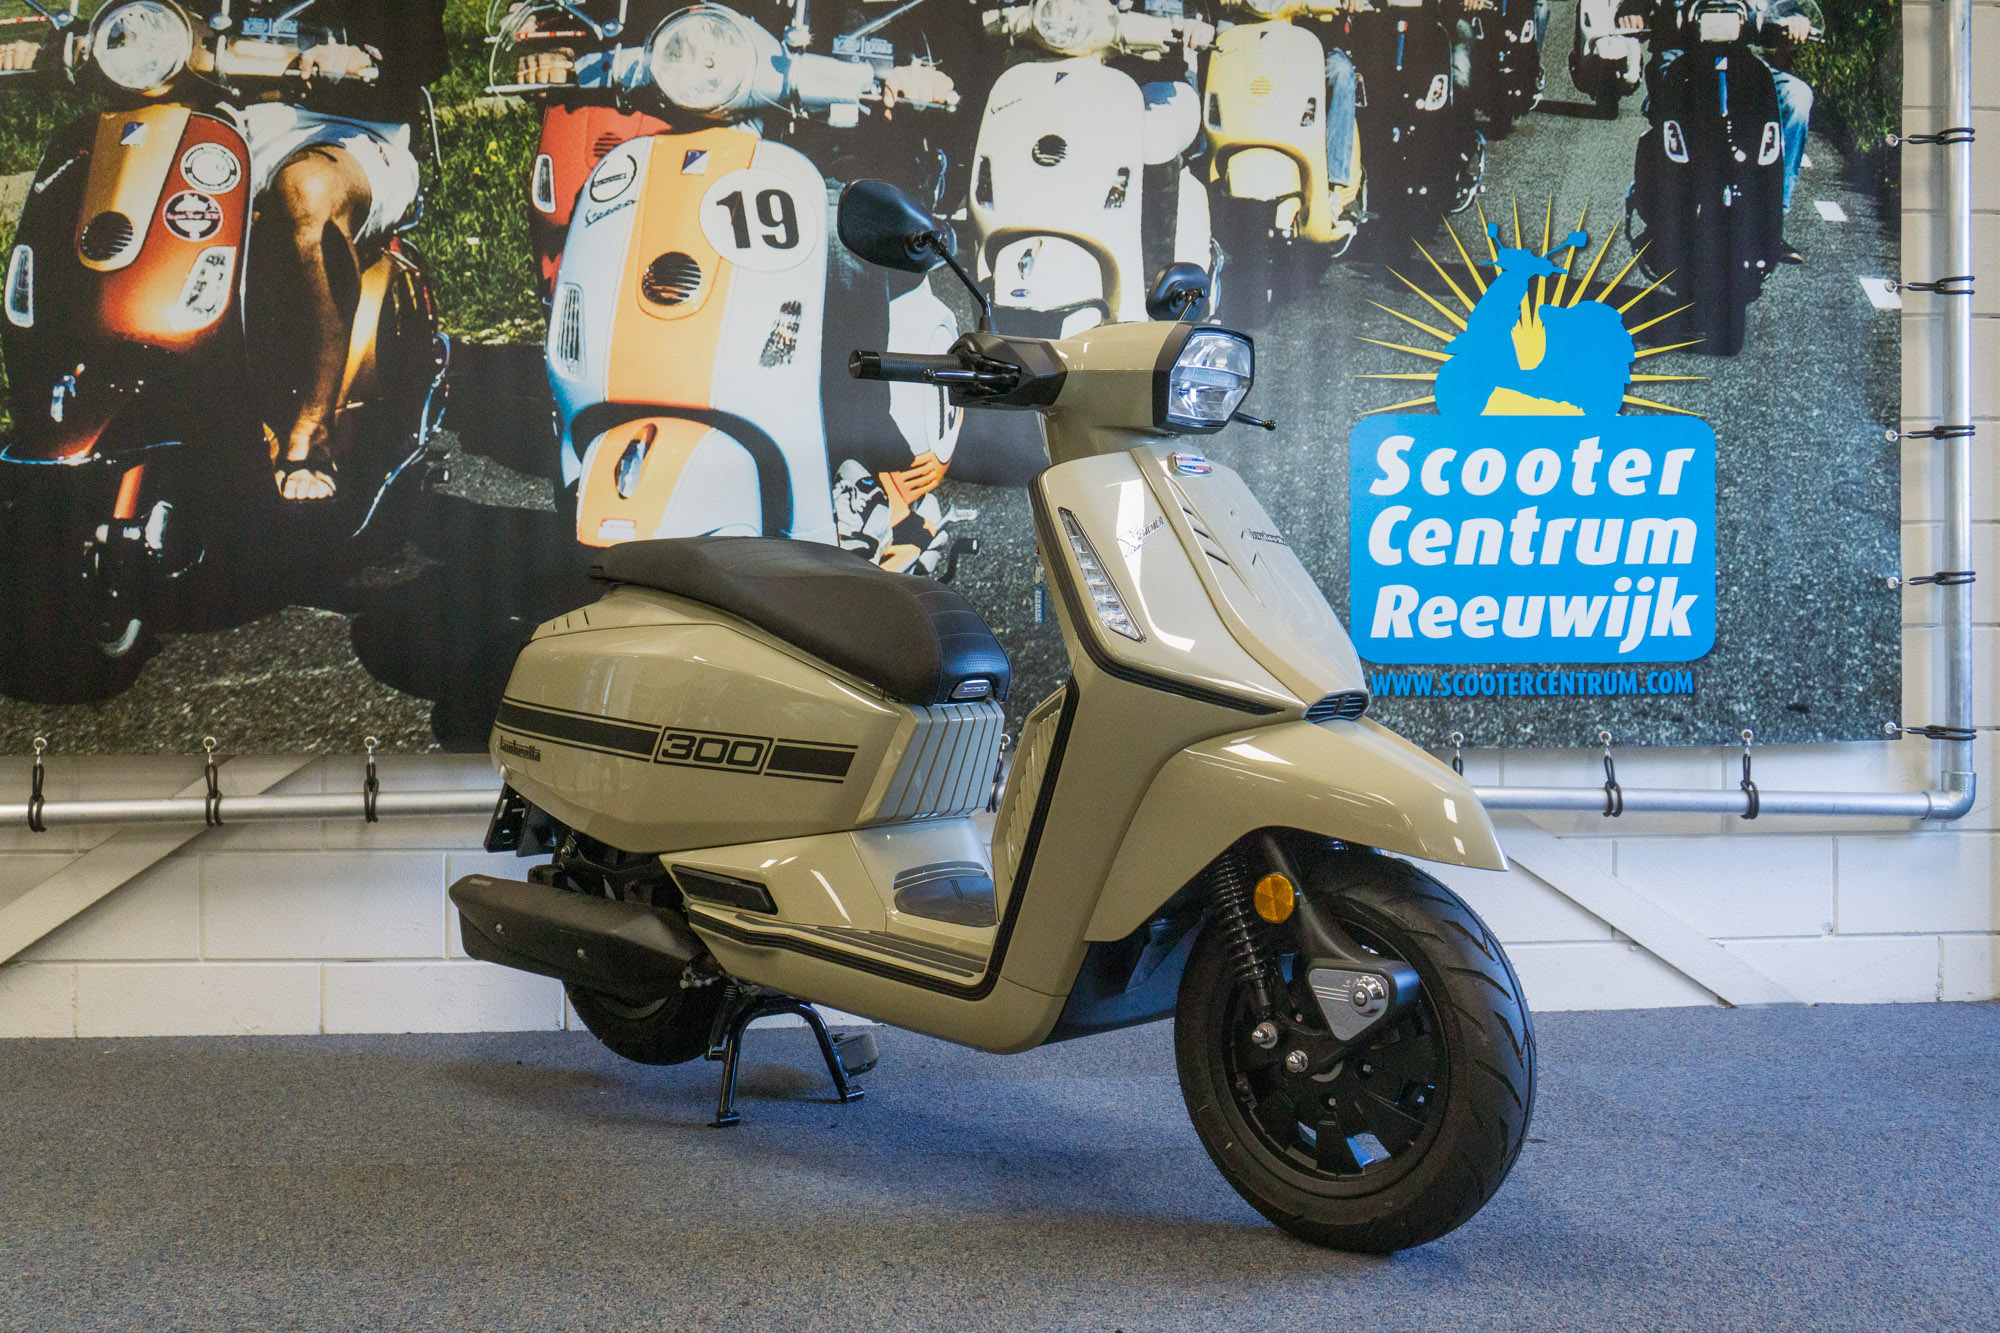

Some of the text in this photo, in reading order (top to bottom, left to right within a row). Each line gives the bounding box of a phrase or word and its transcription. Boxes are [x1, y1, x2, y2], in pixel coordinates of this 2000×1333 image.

[716, 188, 800, 250] 19
[1368, 435, 1696, 497] Scooter
[1368, 504, 1698, 566] Centrum
[1370, 576, 1699, 654] Reeuwijk
[1370, 671, 1695, 697] WWW.SCOOTERCENTRUM.COM
[660, 733, 764, 767] 300
